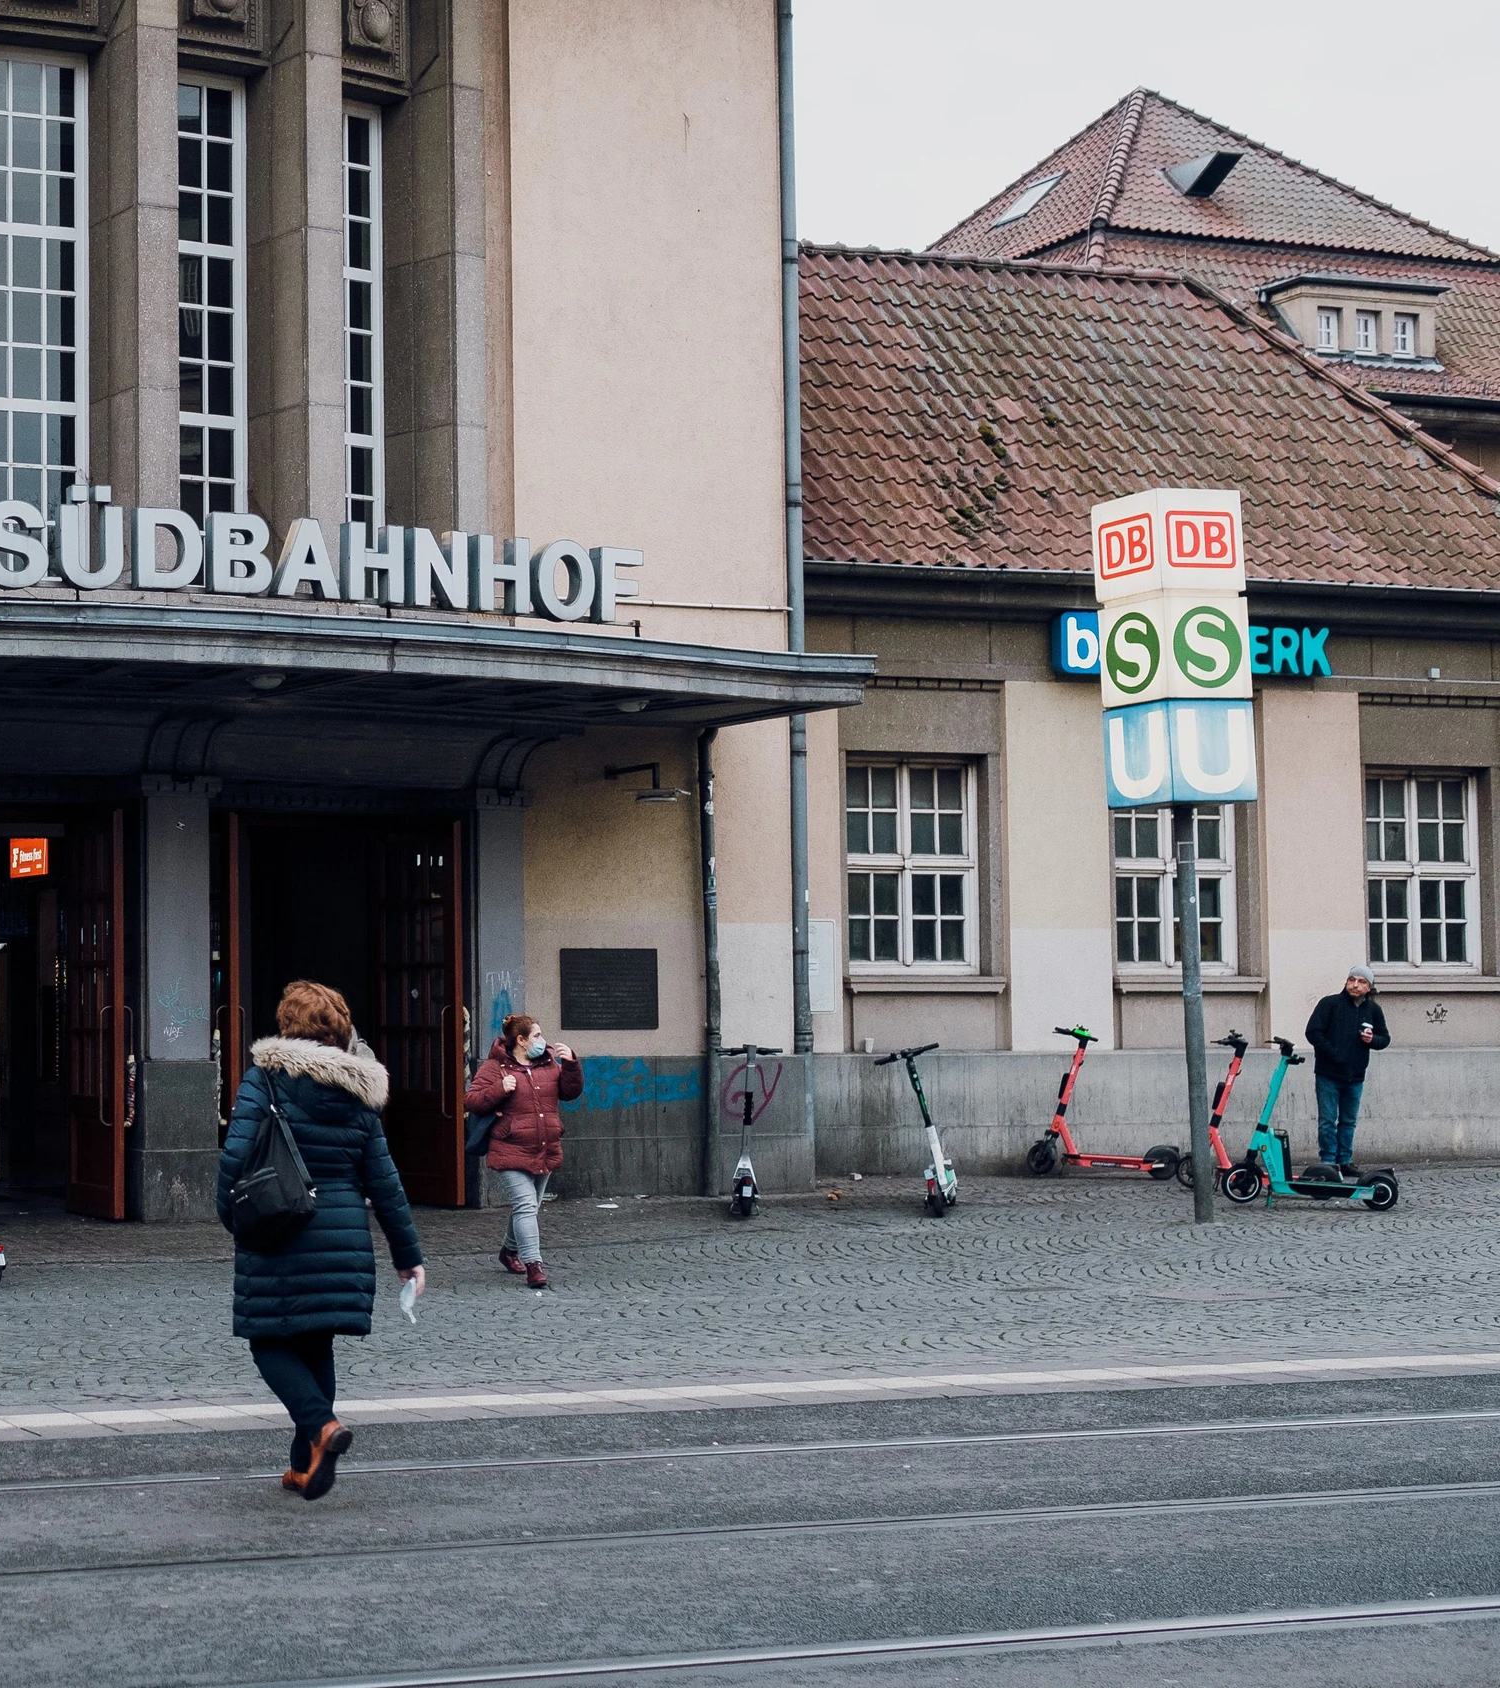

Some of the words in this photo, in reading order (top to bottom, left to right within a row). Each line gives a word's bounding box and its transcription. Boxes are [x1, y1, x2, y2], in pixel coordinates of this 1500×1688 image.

[1104, 525, 1148, 570] DB
[1175, 520, 1228, 560] DB
[1115, 619, 1153, 688] S
[1184, 612, 1231, 682] S
[1108, 710, 1167, 800] U
[1176, 707, 1246, 795] U
[1264, 1156, 1277, 1178] TIER
